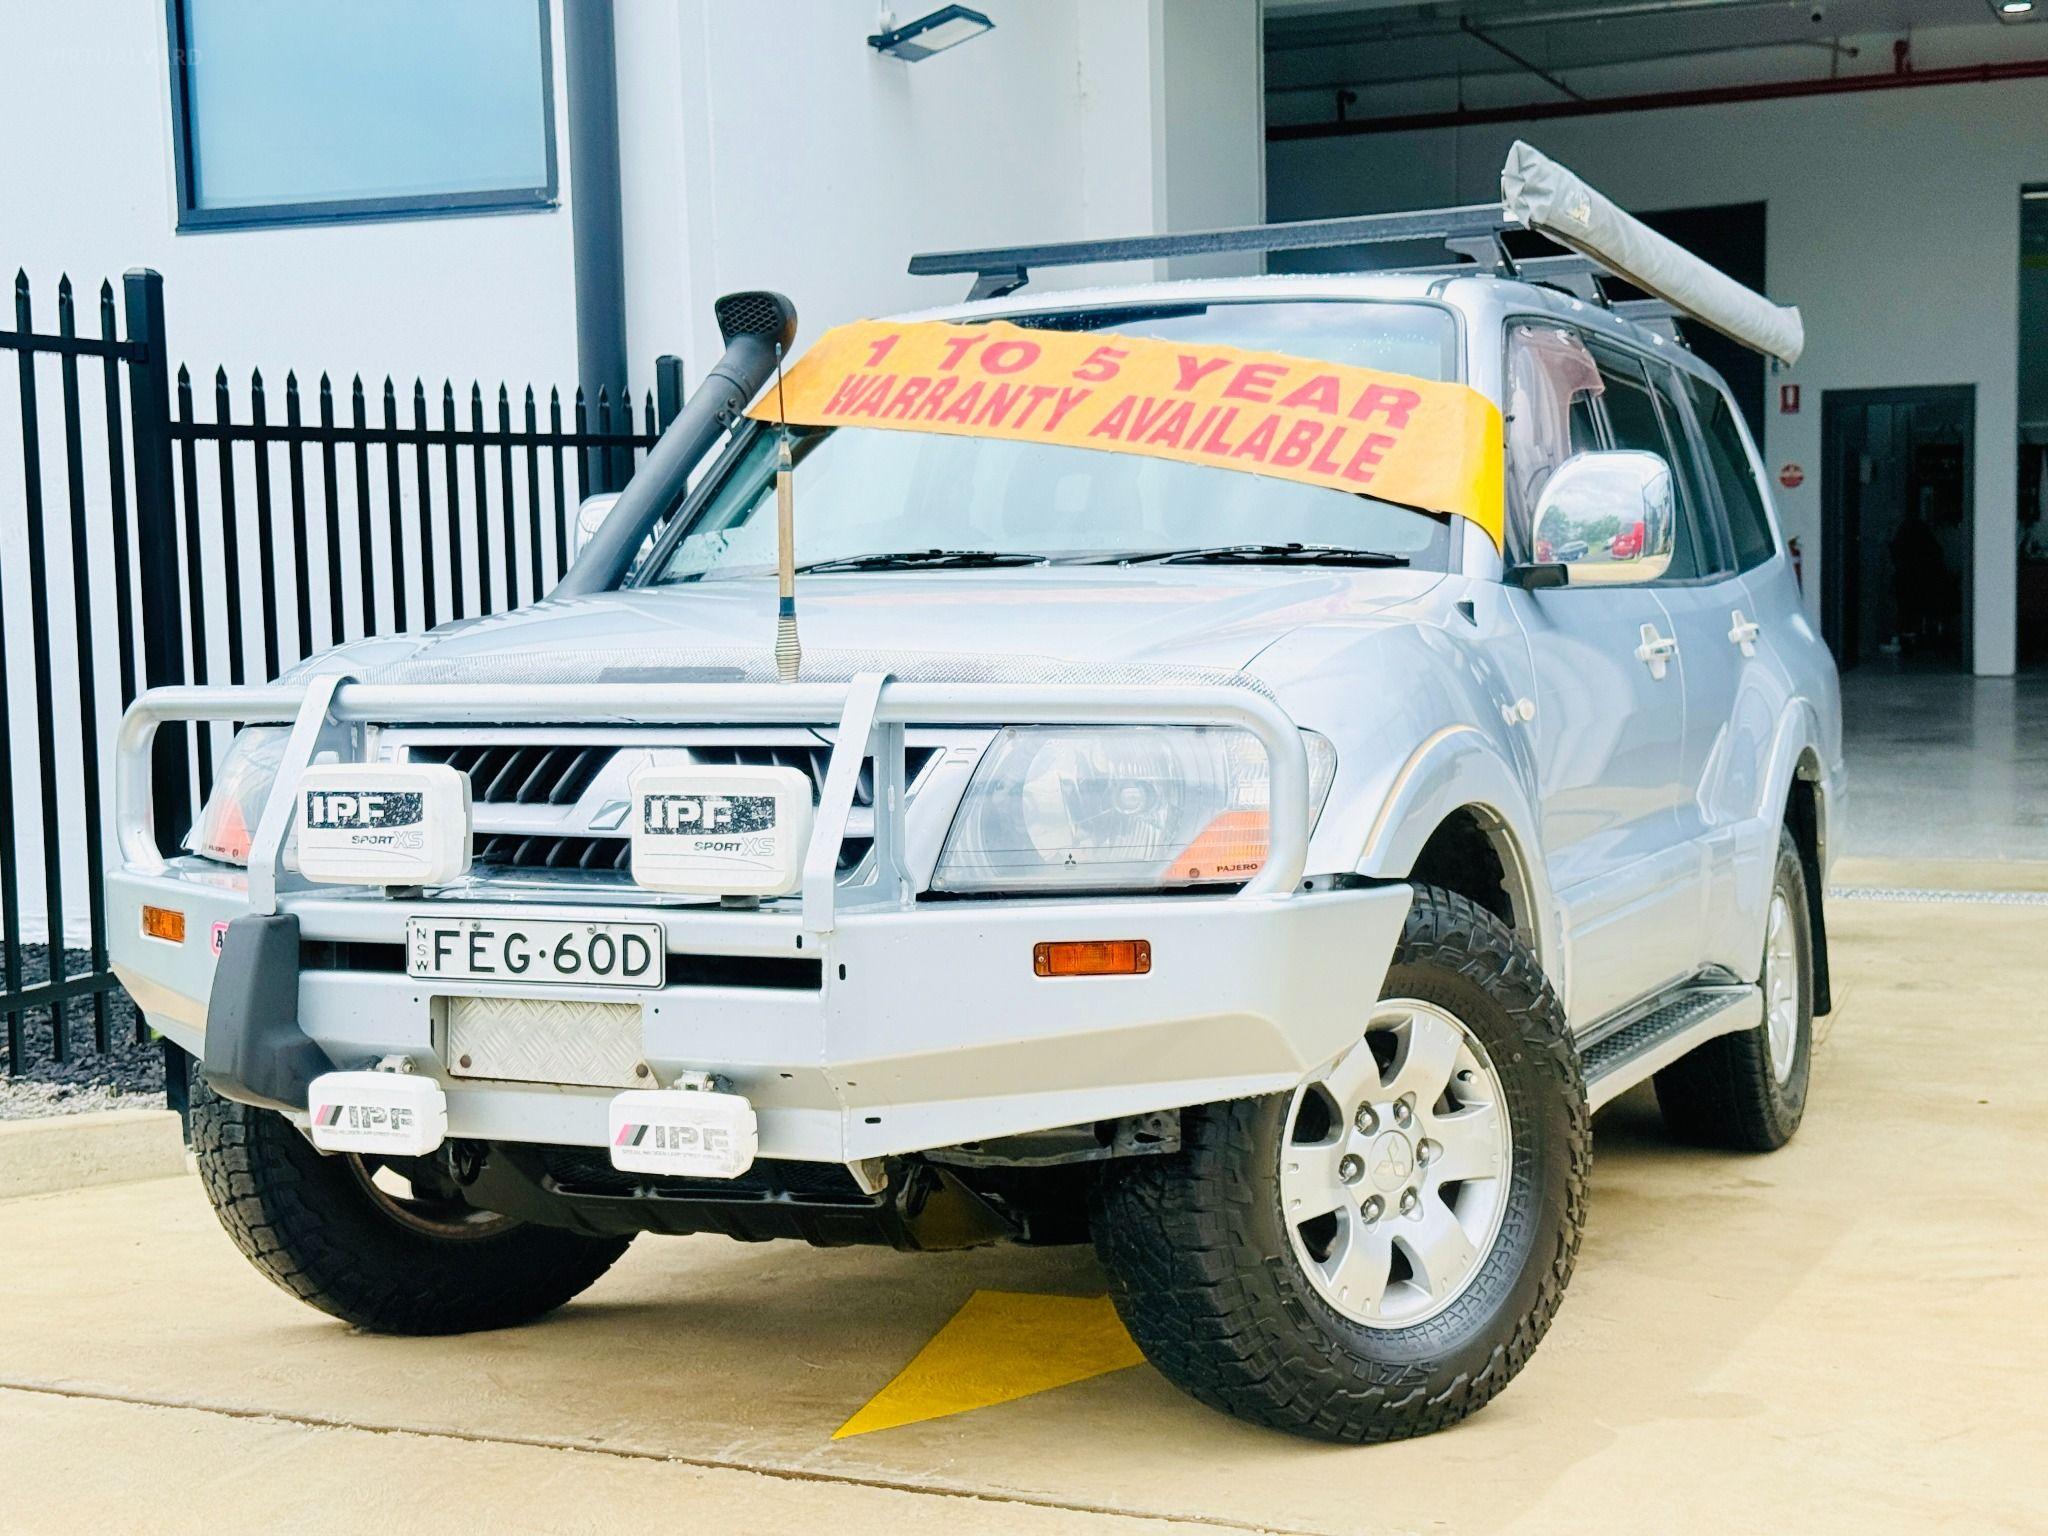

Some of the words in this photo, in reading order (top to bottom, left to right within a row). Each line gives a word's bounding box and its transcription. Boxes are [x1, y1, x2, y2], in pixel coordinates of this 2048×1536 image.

[864, 333, 898, 367] 1
[942, 335, 1041, 375] TO
[1073, 347, 1128, 381] 5
[1177, 355, 1421, 429] YEAR
[822, 374, 1092, 433] WARRANTY
[1091, 396, 1395, 483] AVAILABLE
[313, 796, 384, 823] IPF
[650, 800, 731, 829] IPF
[1216, 863, 1258, 873] PAJERO
[349, 1105, 413, 1130] IPF
[656, 1125, 729, 1151] IPF
